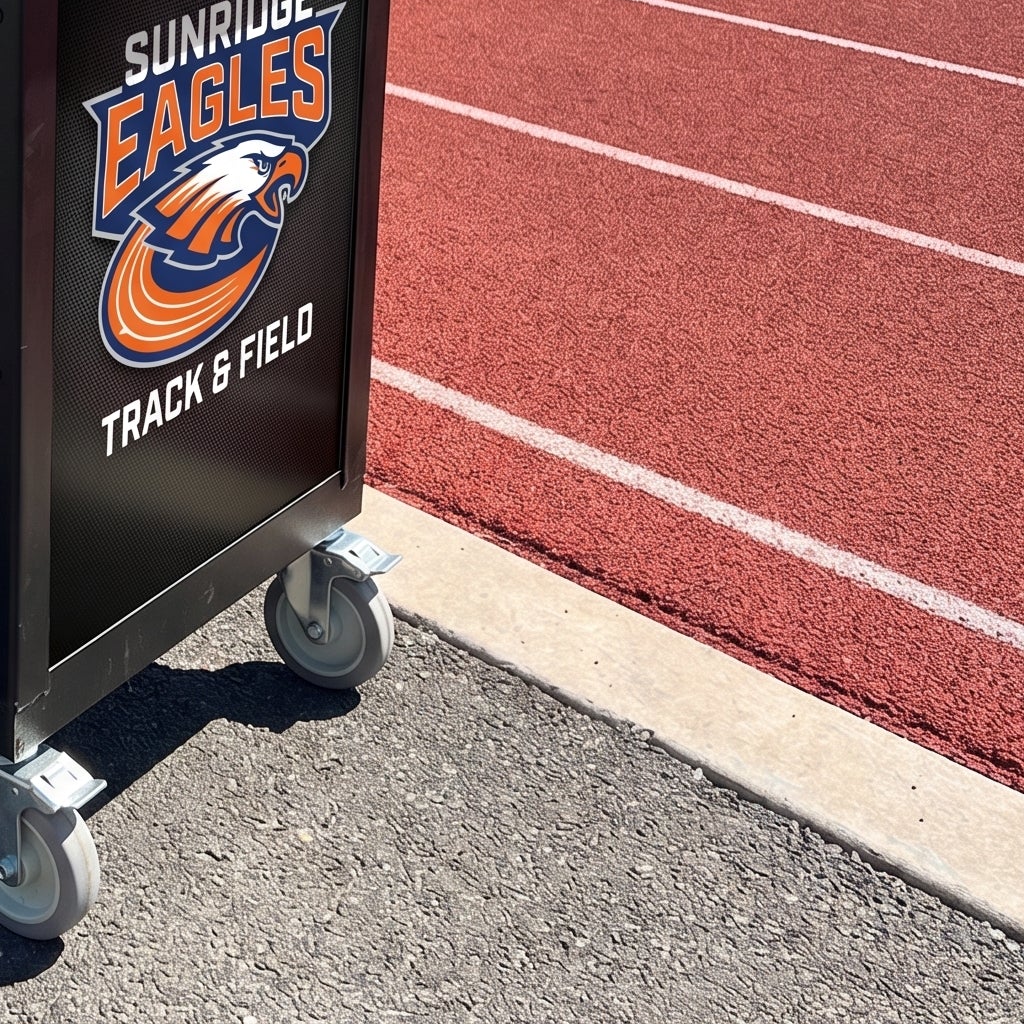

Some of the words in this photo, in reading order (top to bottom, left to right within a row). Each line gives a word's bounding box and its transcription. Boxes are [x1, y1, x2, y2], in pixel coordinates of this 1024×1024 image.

[101, 24, 326, 220] EAGLES
[101, 362, 204, 457] TRACK
[212, 349, 229, 394] &
[239, 302, 313, 379] FIELD
